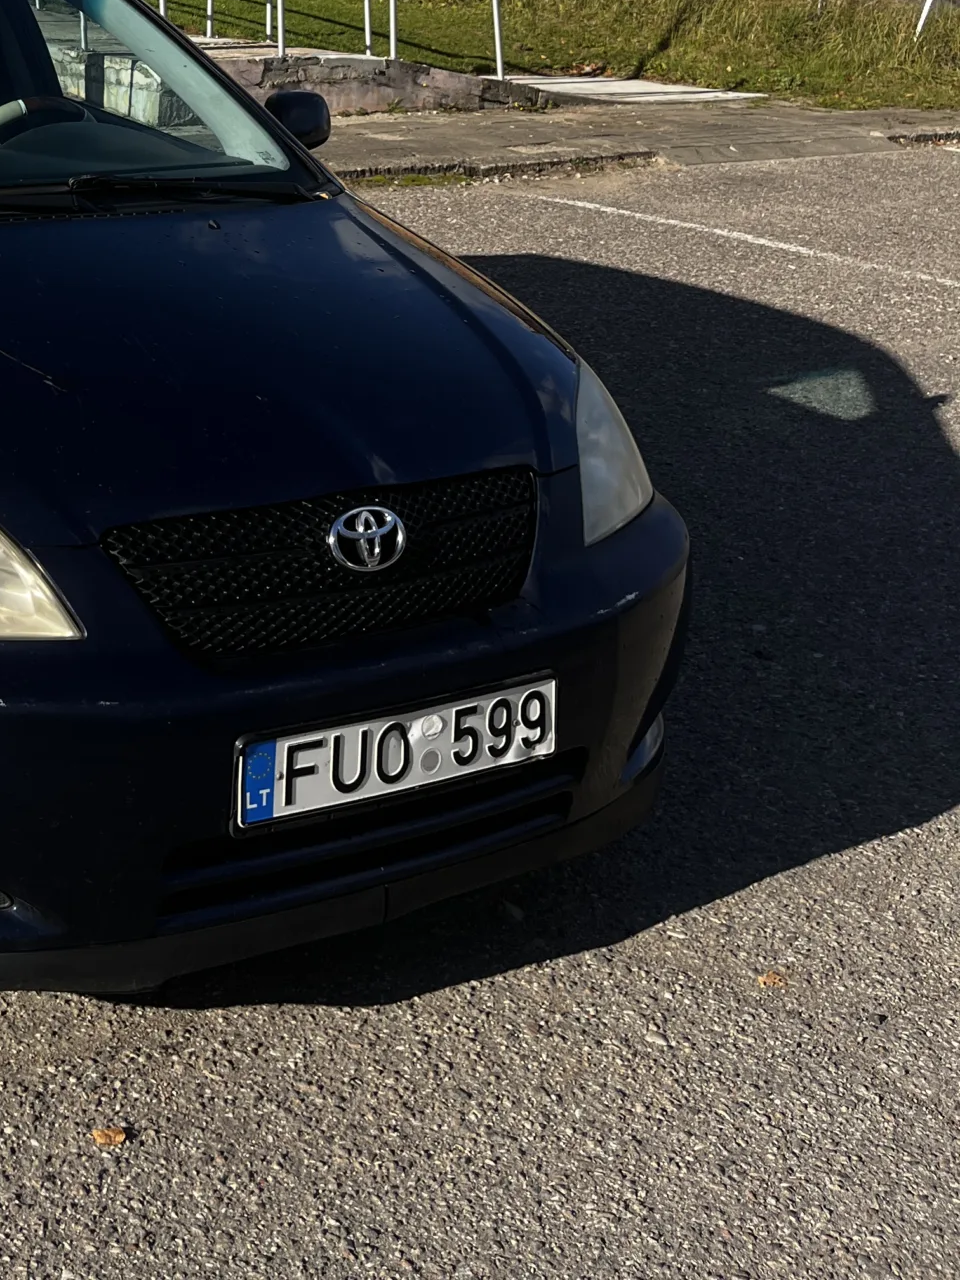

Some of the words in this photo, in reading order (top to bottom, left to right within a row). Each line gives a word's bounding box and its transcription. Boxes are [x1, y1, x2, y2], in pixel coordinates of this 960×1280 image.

[282, 721, 410, 807] FUO
[451, 689, 546, 766] 599
[246, 789, 270, 809] LT
